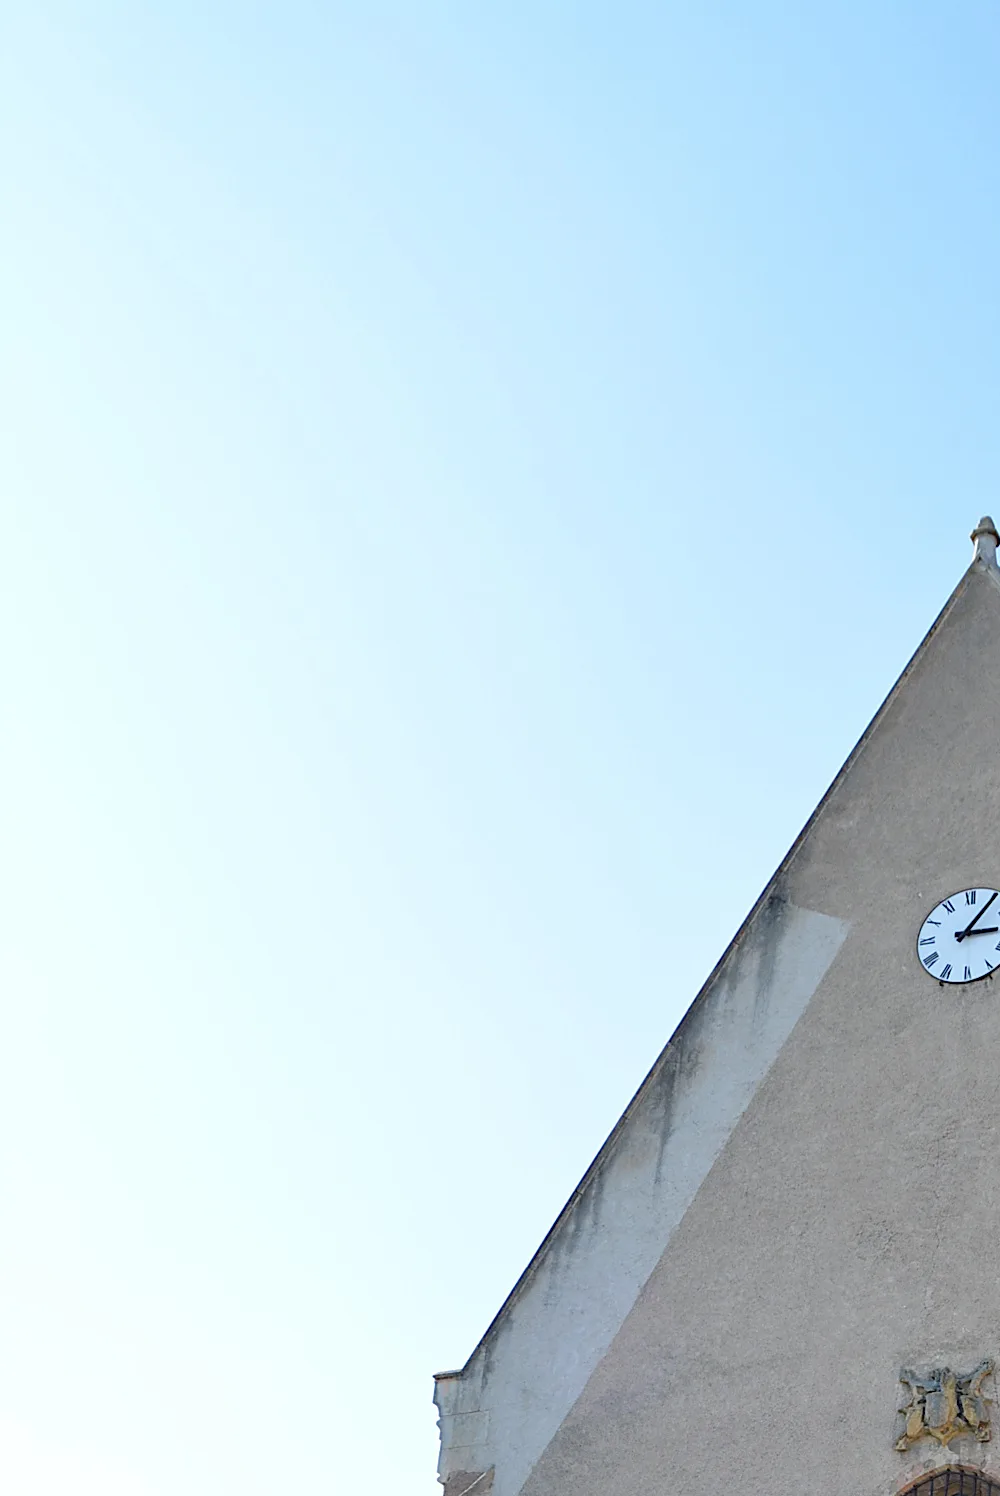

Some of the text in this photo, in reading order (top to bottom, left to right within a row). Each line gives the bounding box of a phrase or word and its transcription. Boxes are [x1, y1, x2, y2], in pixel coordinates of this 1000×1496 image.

[965, 891, 976, 905] XII
[942, 900, 955, 915] XI
[927, 918, 941, 927] X
[920, 936, 935, 946] IX
[923, 952, 939, 968] VIII
[984, 959, 993, 970] V
[940, 964, 953, 979] VII
[965, 966, 971, 979] VI
